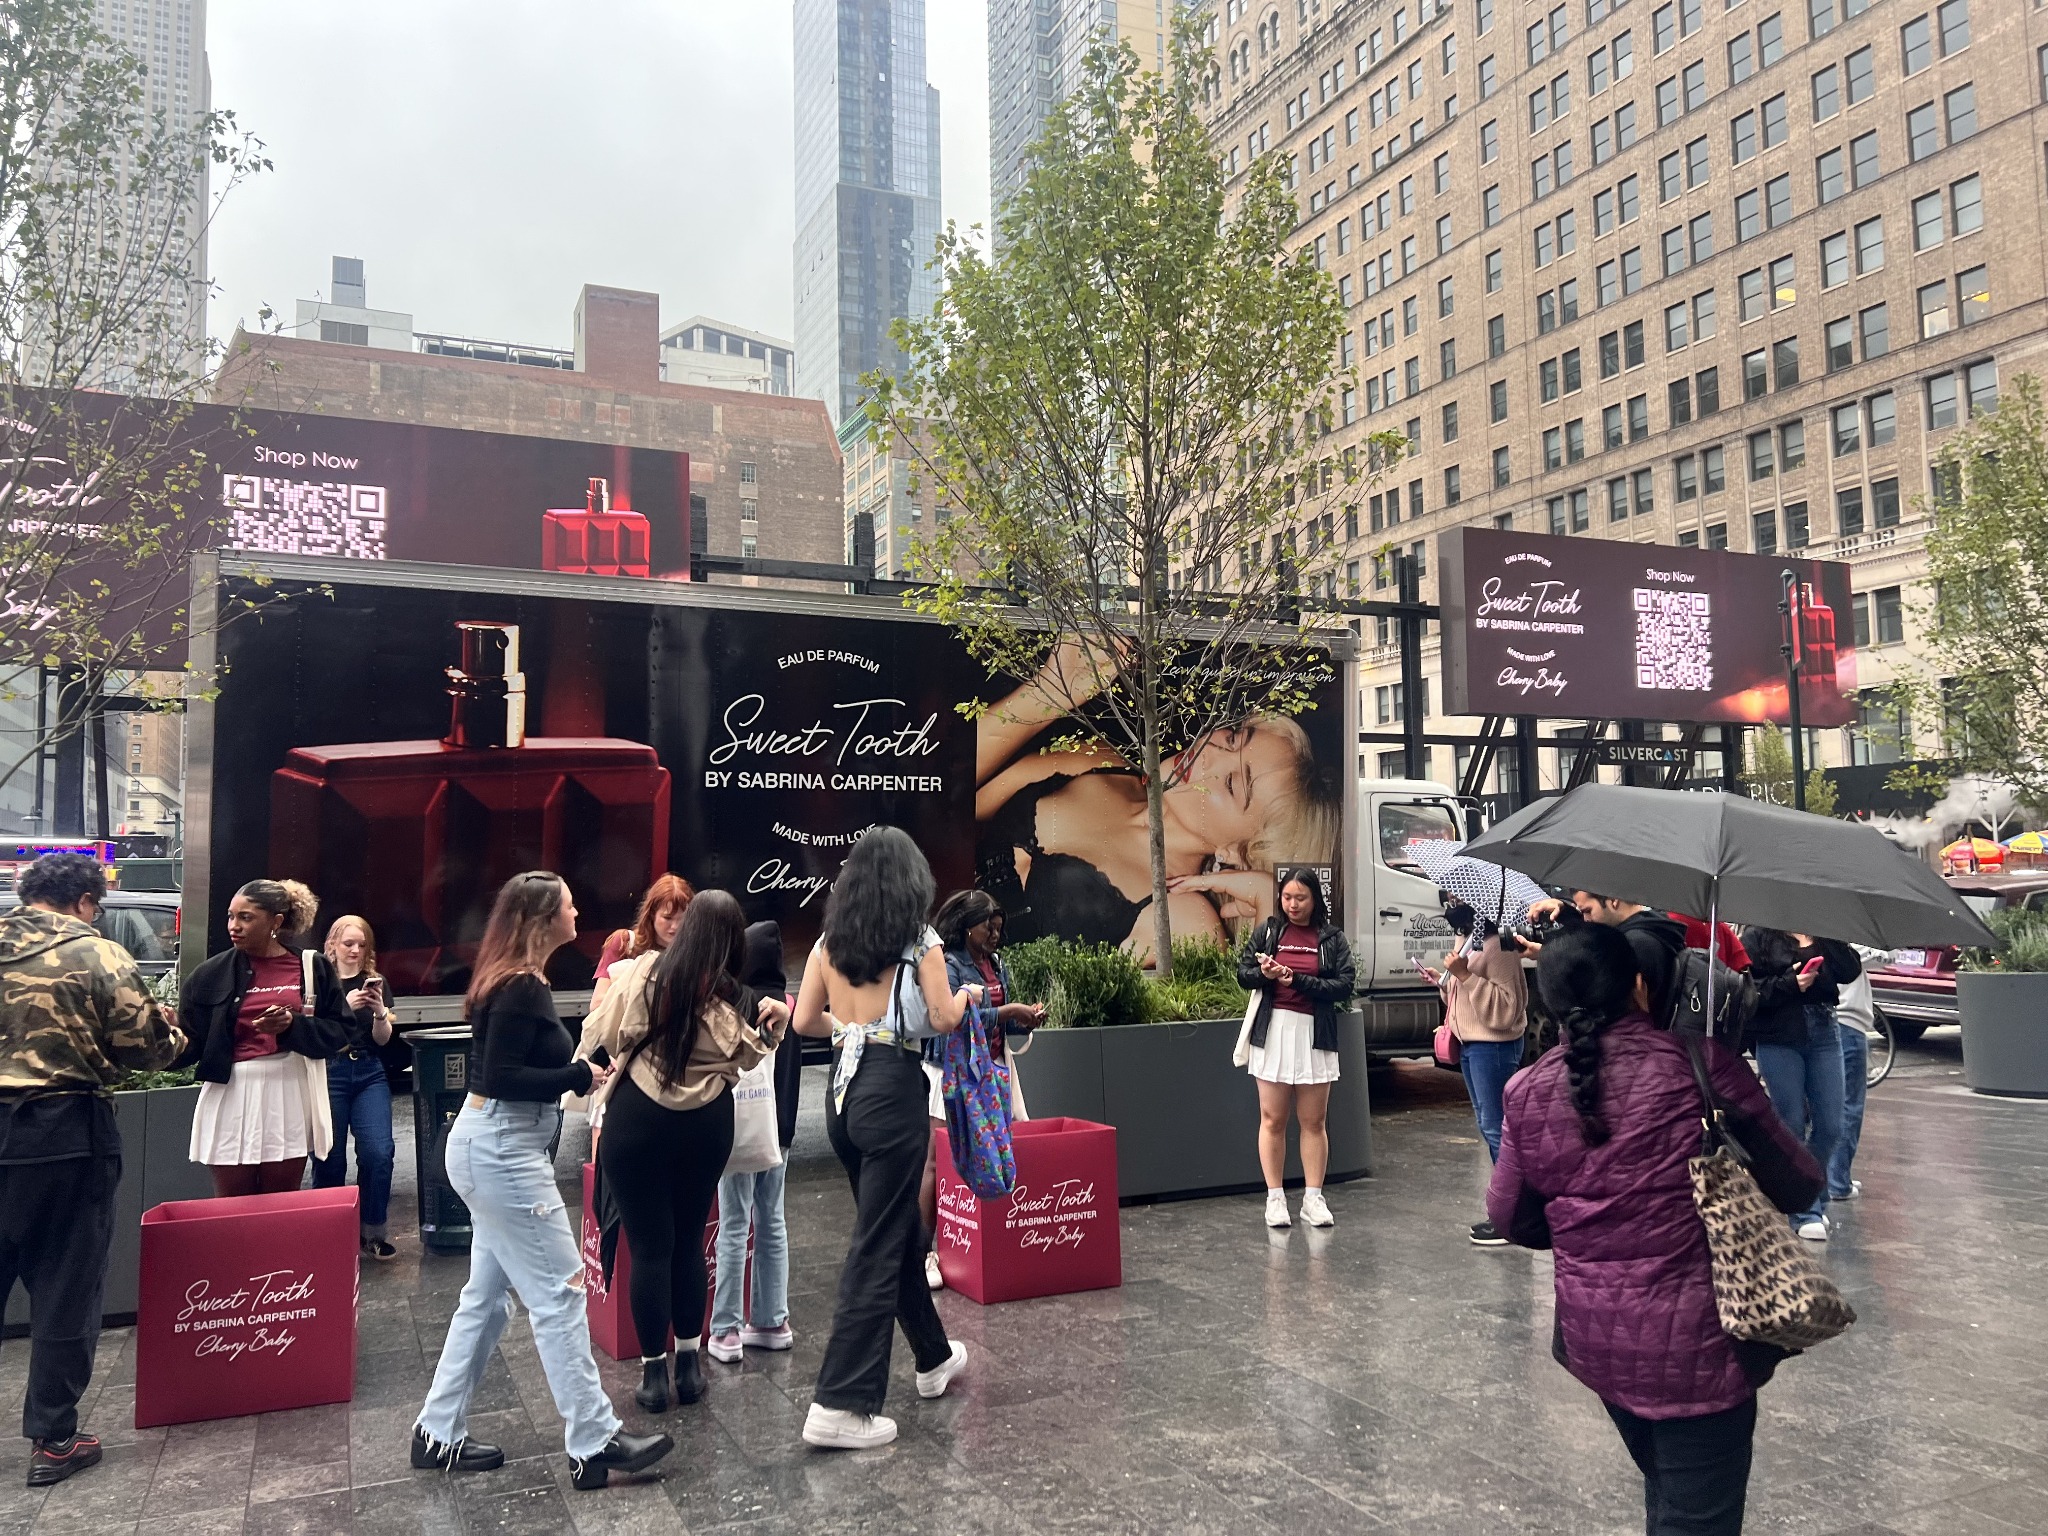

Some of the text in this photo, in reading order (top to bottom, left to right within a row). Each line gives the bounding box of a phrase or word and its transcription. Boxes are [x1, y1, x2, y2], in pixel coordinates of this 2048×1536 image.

[254, 445, 359, 470] Shop Now
[1504, 552, 1552, 568] EAU DE PARFUM
[1646, 568, 1695, 584] Shop Now
[1477, 576, 1582, 619] Sweet Tooth
[1475, 617, 1584, 635] BY SABRINA CARPENTER
[777, 649, 881, 674] EAU DE PARFUM
[1506, 646, 1557, 663] MADE WITH LOVE
[1497, 666, 1568, 697] Cherry Baby
[709, 693, 941, 767] Sweet Tooth
[1608, 746, 1688, 761] SILVERCAST
[704, 771, 943, 792] BY SABRINA CARPENTER
[771, 821, 810, 845] MADE
[812, 834, 845, 847] WITH
[746, 858, 829, 908] Cherry
[1403, 929, 1456, 939] transportation
[1409, 912, 1450, 931] Moreno
[954, 1184, 977, 1214] Tooth
[1006, 1178, 1096, 1219] Sweet Tooth
[1005, 1210, 1098, 1229] BY SABRINA CARPENTER
[1020, 1225, 1086, 1253] Cherry Baby
[176, 1279, 250, 1321] Sweet
[249, 1269, 316, 1312] Tooth
[174, 1307, 317, 1333] BY SABRINA CARPENTER
[194, 1327, 297, 1362] Cherry Baby
